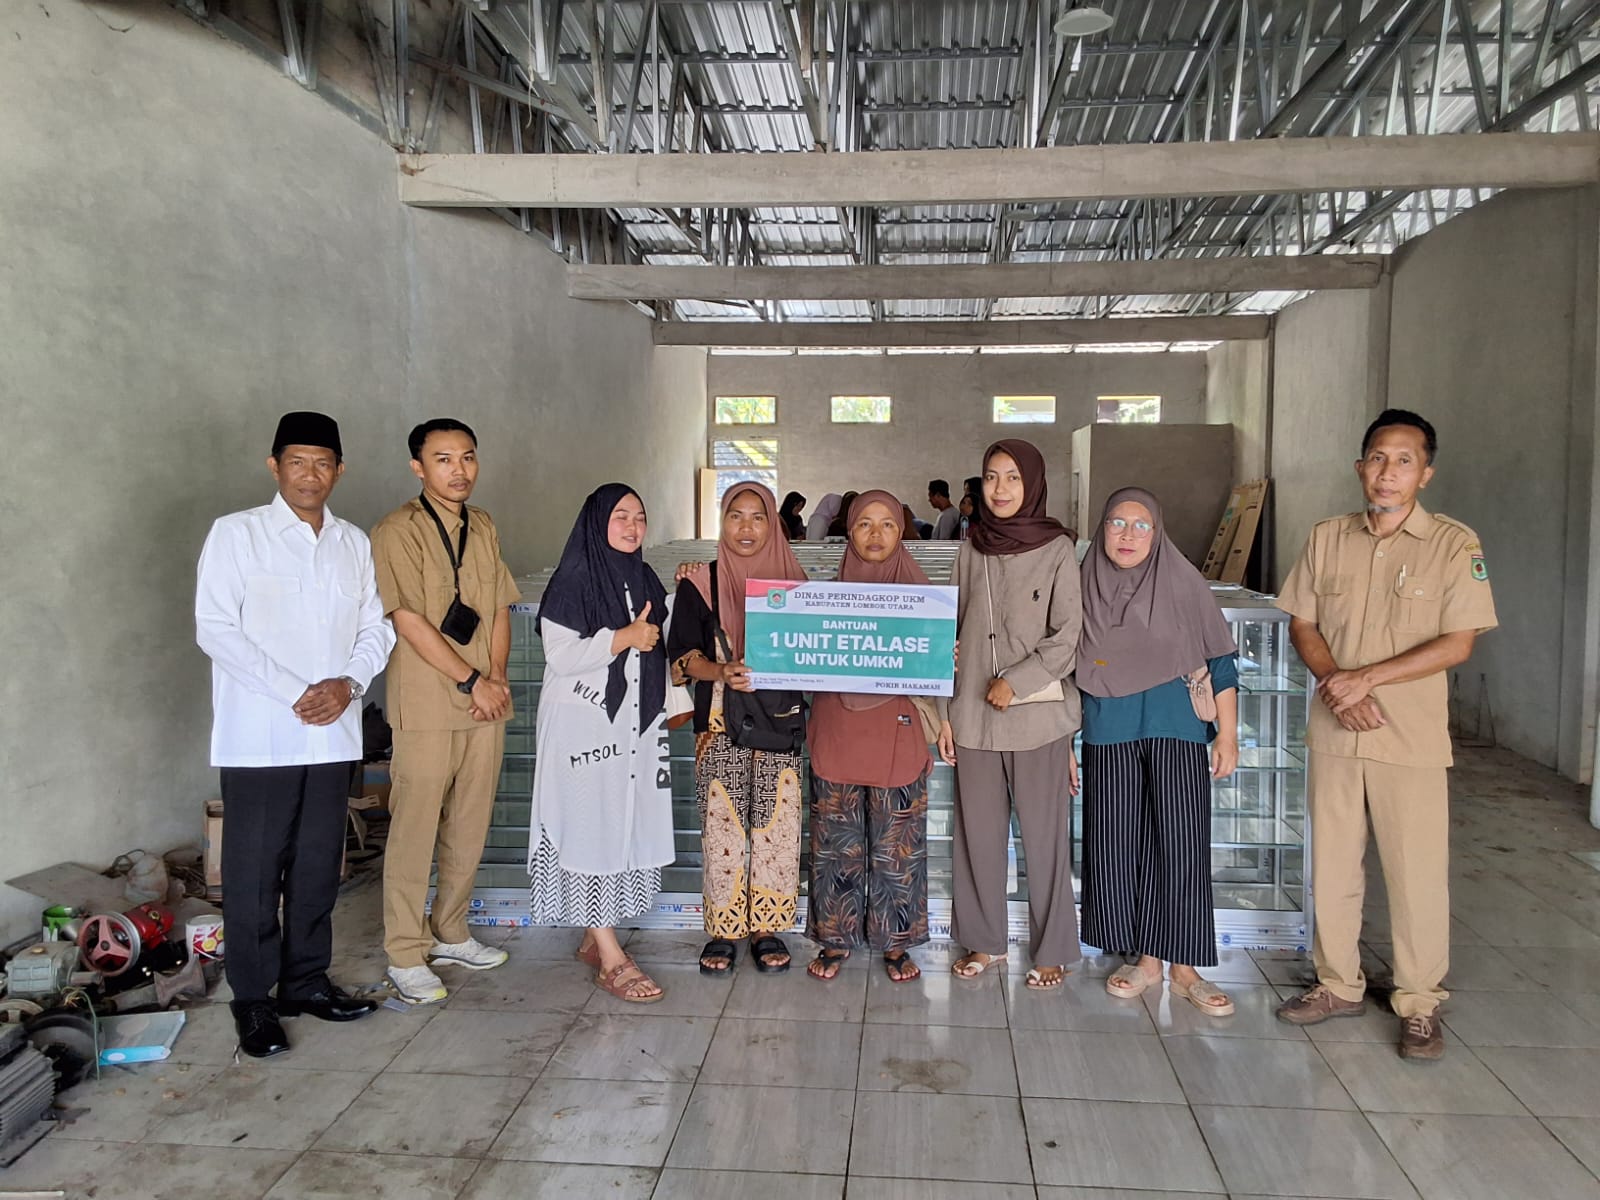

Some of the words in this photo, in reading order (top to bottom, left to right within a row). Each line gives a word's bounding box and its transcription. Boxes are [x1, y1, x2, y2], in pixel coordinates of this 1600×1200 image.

[794, 591, 825, 600] DINAS
[827, 592, 900, 602] PERINDAGKOP
[902, 595, 925, 603] UKM
[822, 620, 877, 631] BANTUAN
[769, 632, 779, 647] 1
[784, 632, 833, 650] UNIT
[837, 635, 930, 653] ETALASE
[794, 652, 849, 667] UNTUK
[852, 655, 903, 669] UMKM
